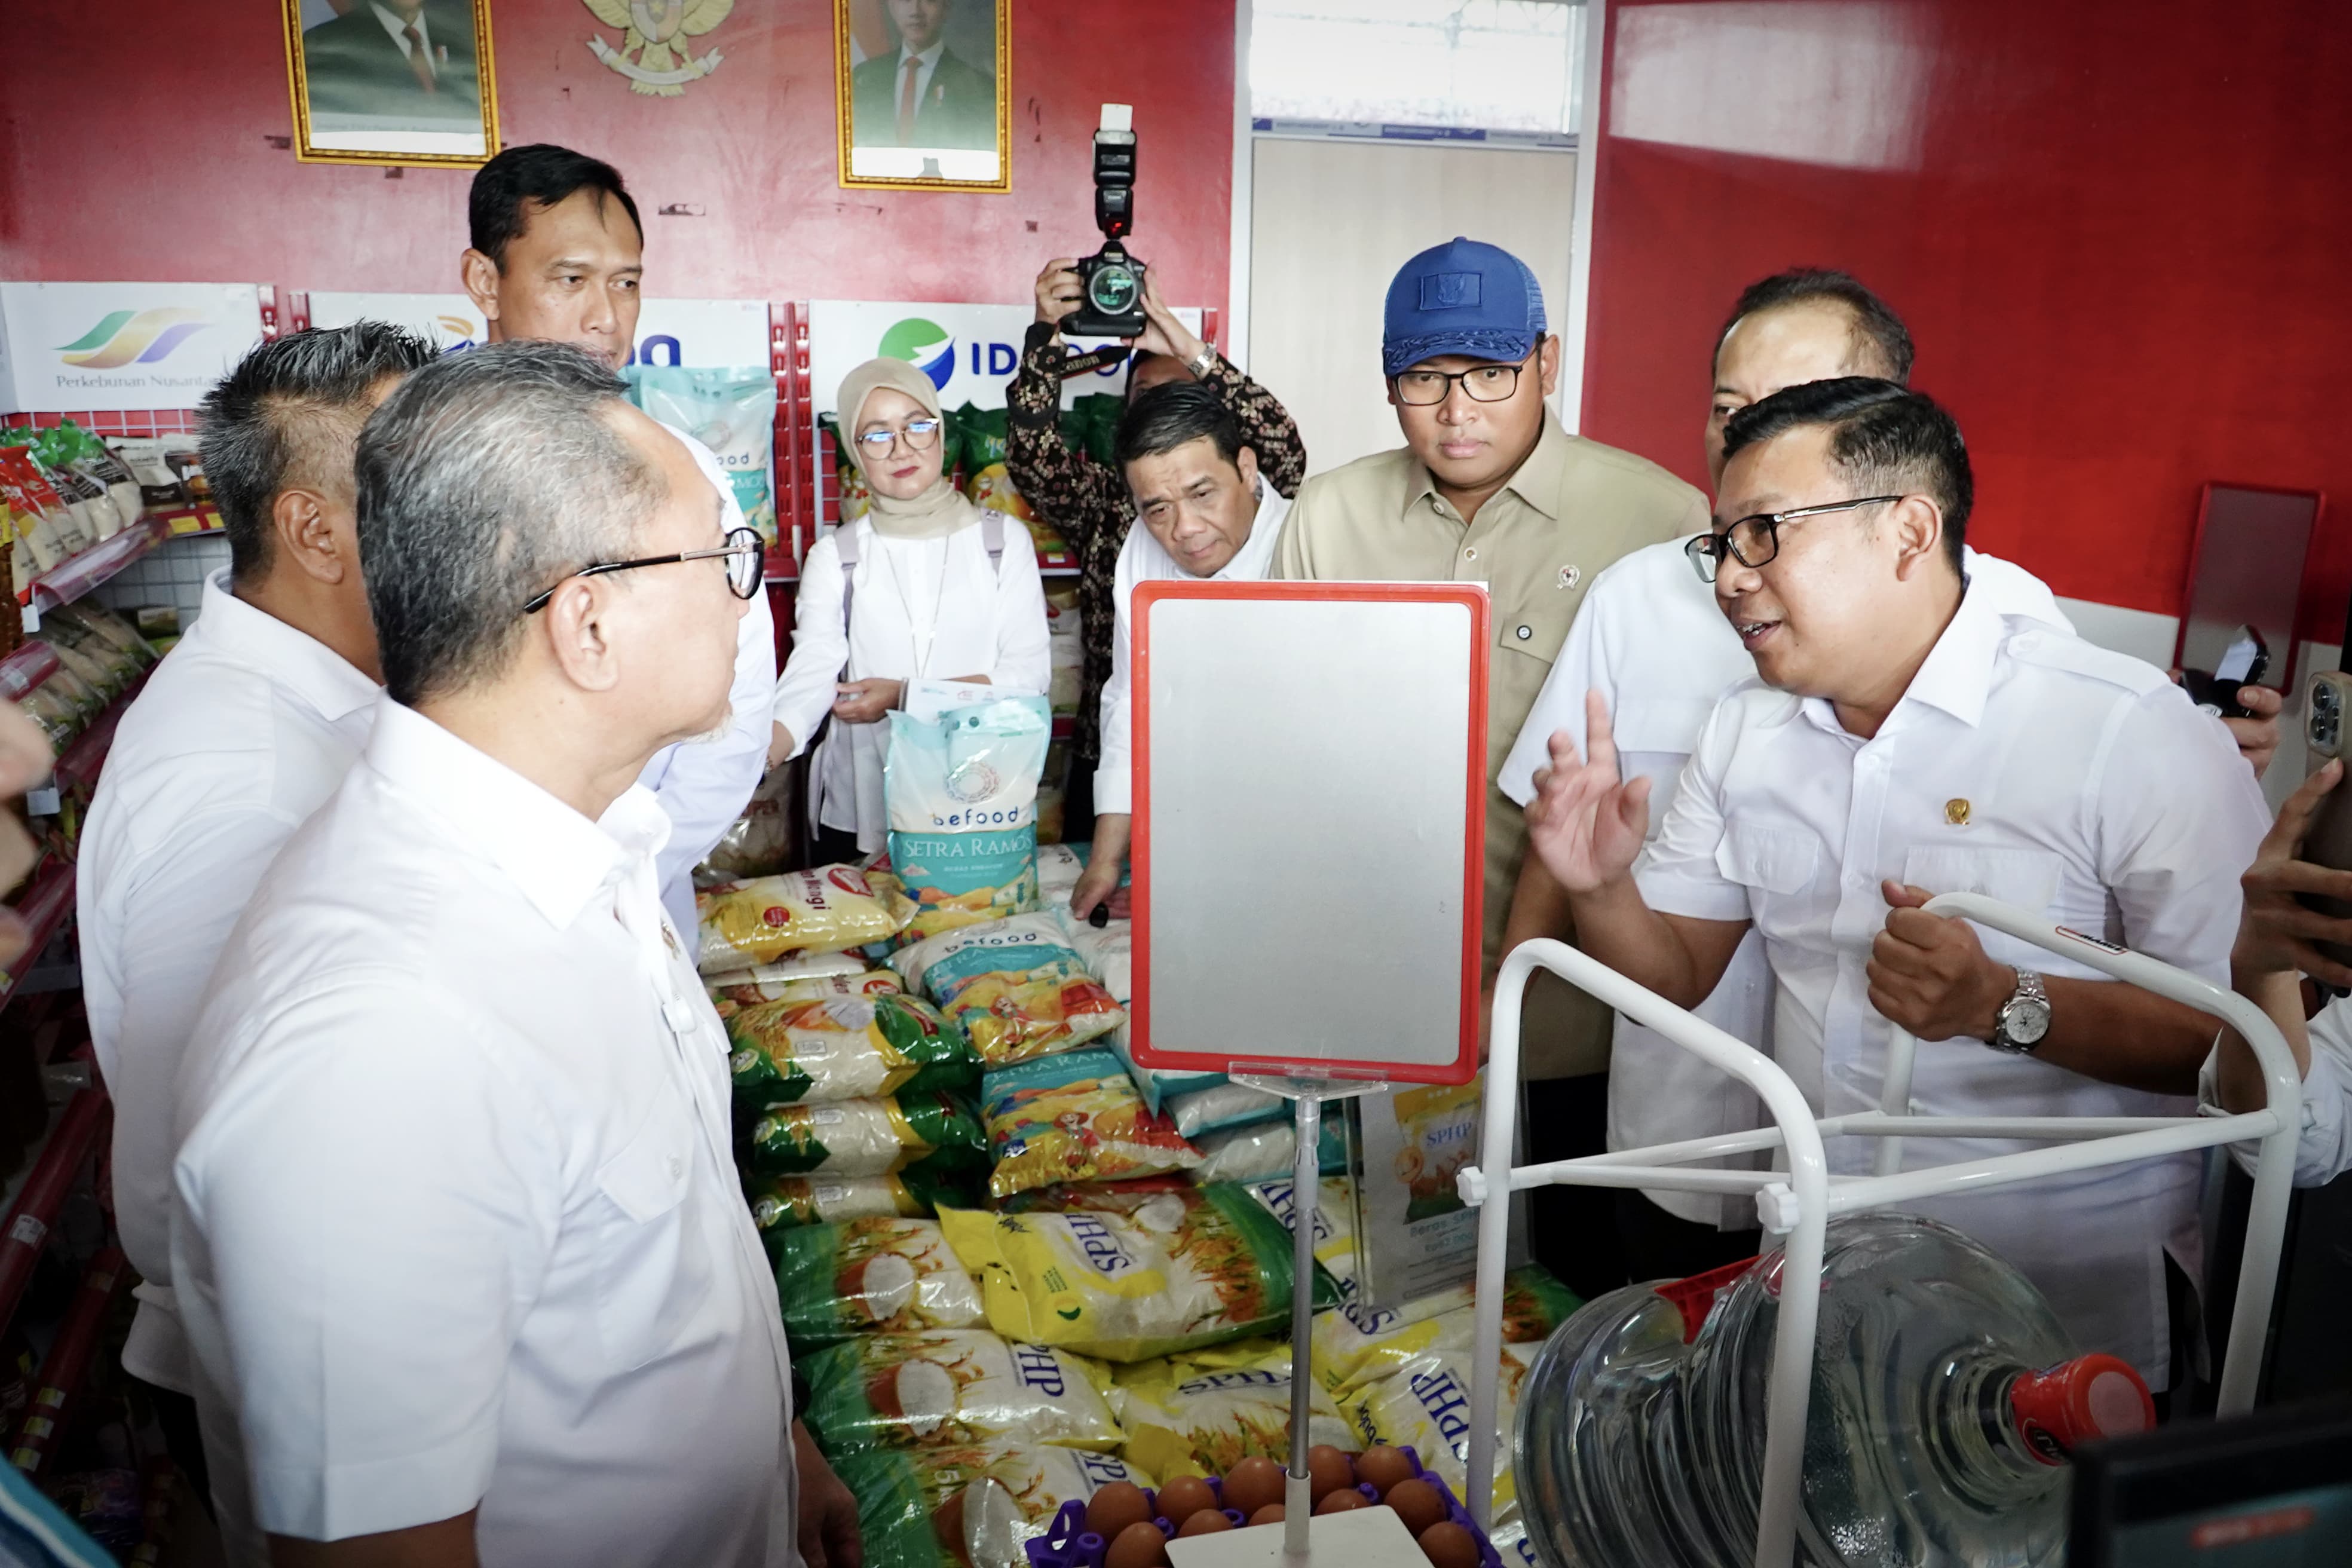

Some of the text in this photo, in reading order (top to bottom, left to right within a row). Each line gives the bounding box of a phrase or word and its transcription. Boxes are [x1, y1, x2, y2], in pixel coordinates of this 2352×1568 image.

[972, 342, 1018, 375] ID
[57, 376, 216, 388] Perkebunan Nusanta
[930, 806, 1018, 826] befood
[905, 834, 1033, 858] SETRA RAMOS
[1427, 1122, 1472, 1147] SPHP
[1178, 1370, 1292, 1394] SPH
